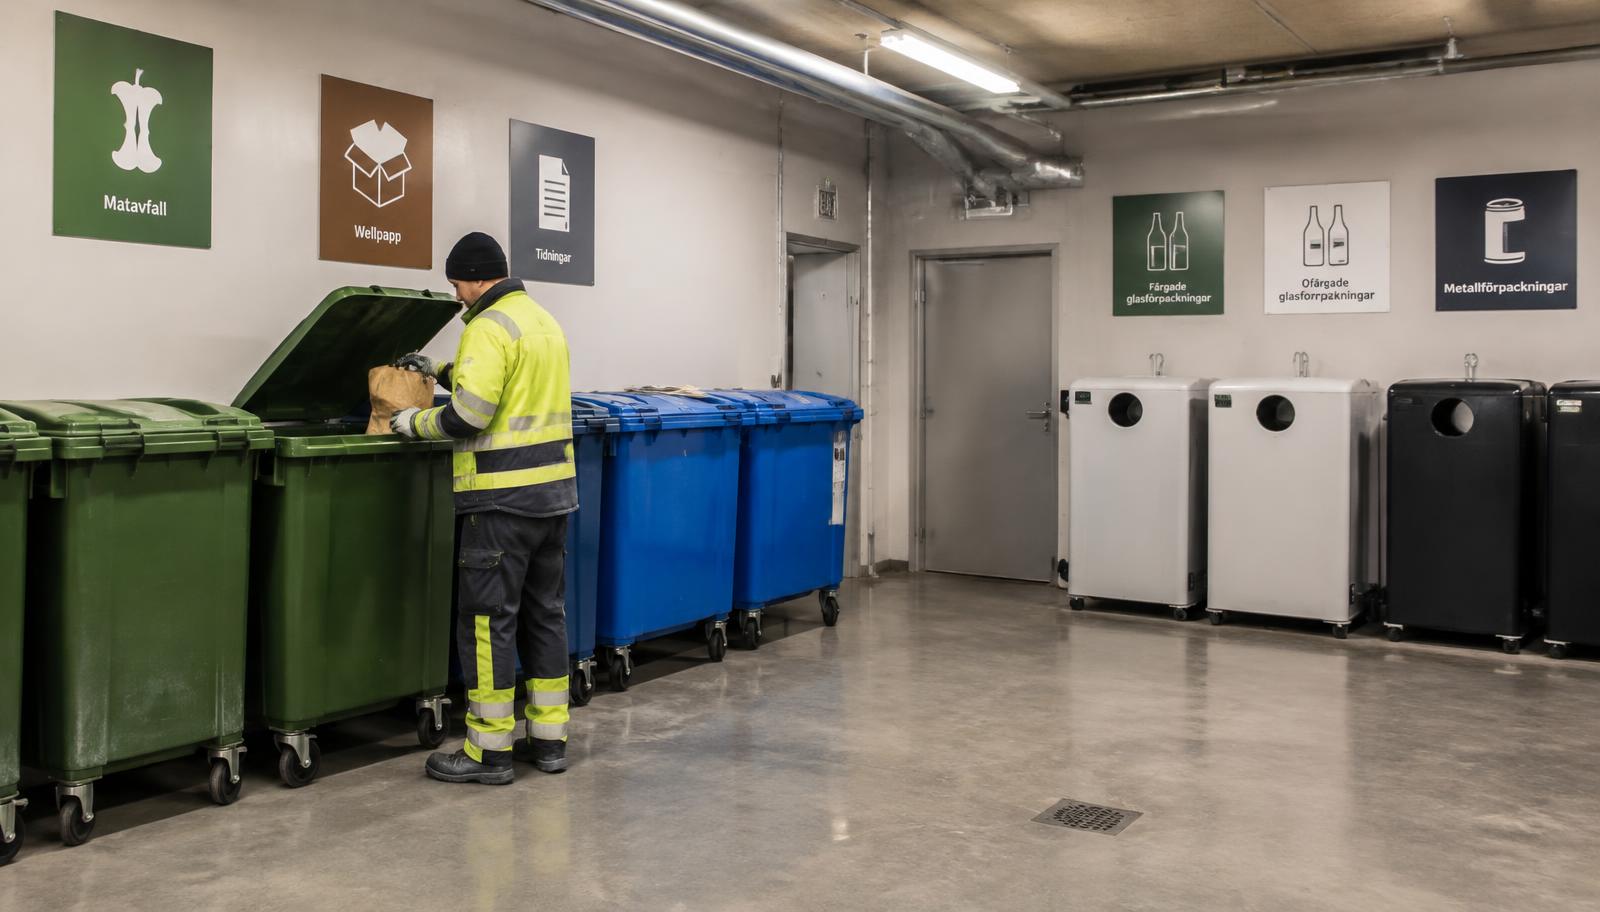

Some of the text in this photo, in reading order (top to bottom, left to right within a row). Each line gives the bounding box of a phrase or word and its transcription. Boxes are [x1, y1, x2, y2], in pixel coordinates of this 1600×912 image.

[104, 194, 167, 216] Matavfall
[354, 224, 401, 245] Wellpapp
[535, 247, 572, 265] Tidningar
[1443, 281, 1569, 295] Metallförpackningar
